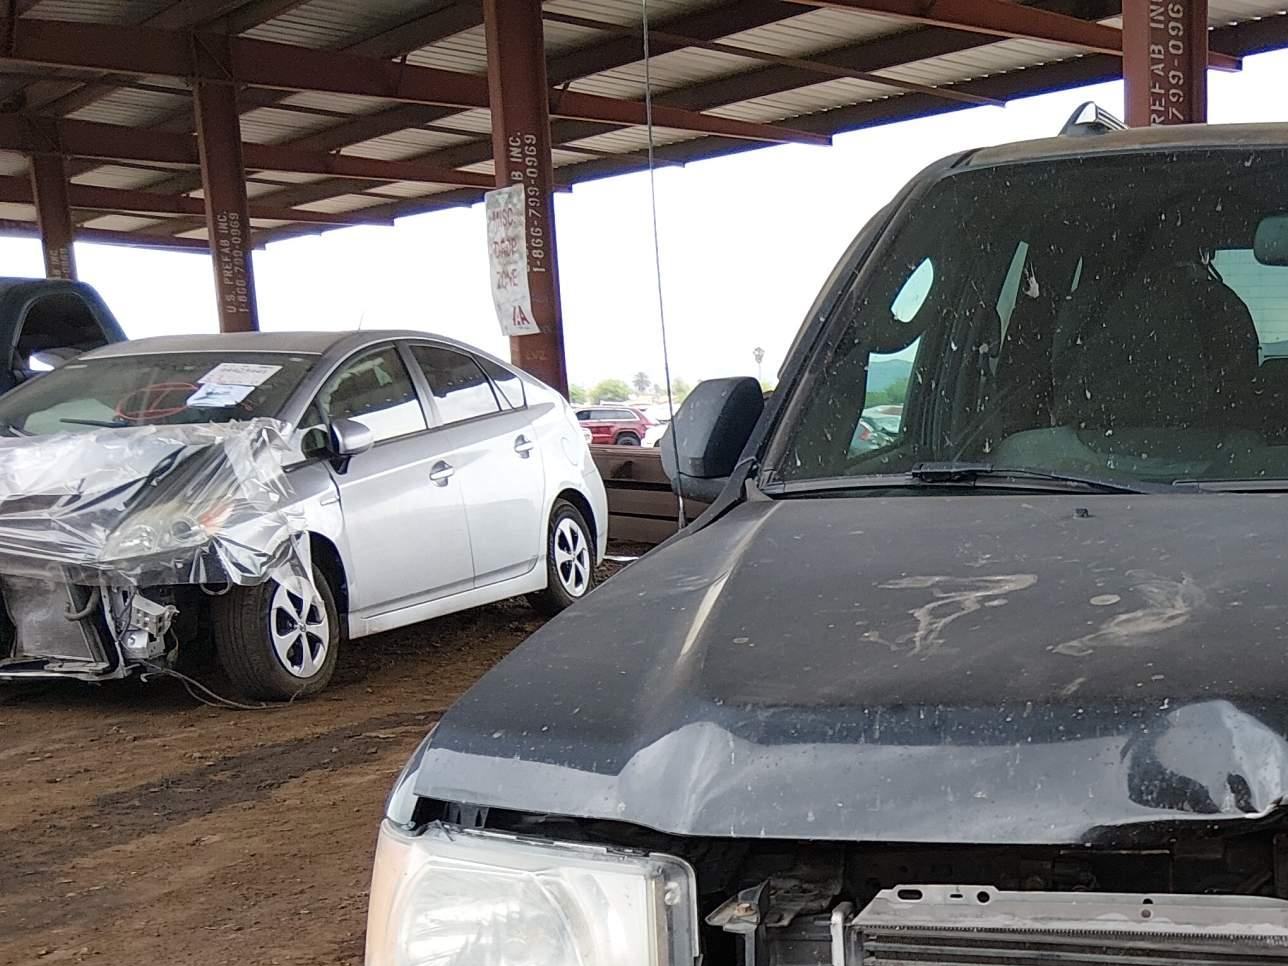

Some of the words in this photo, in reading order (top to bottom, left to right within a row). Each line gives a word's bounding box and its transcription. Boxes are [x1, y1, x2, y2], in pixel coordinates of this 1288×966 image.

[1149, 0, 1164, 29] IN
[509, 130, 522, 165] INC.
[523, 133, 547, 273] 1-866-799-0969
